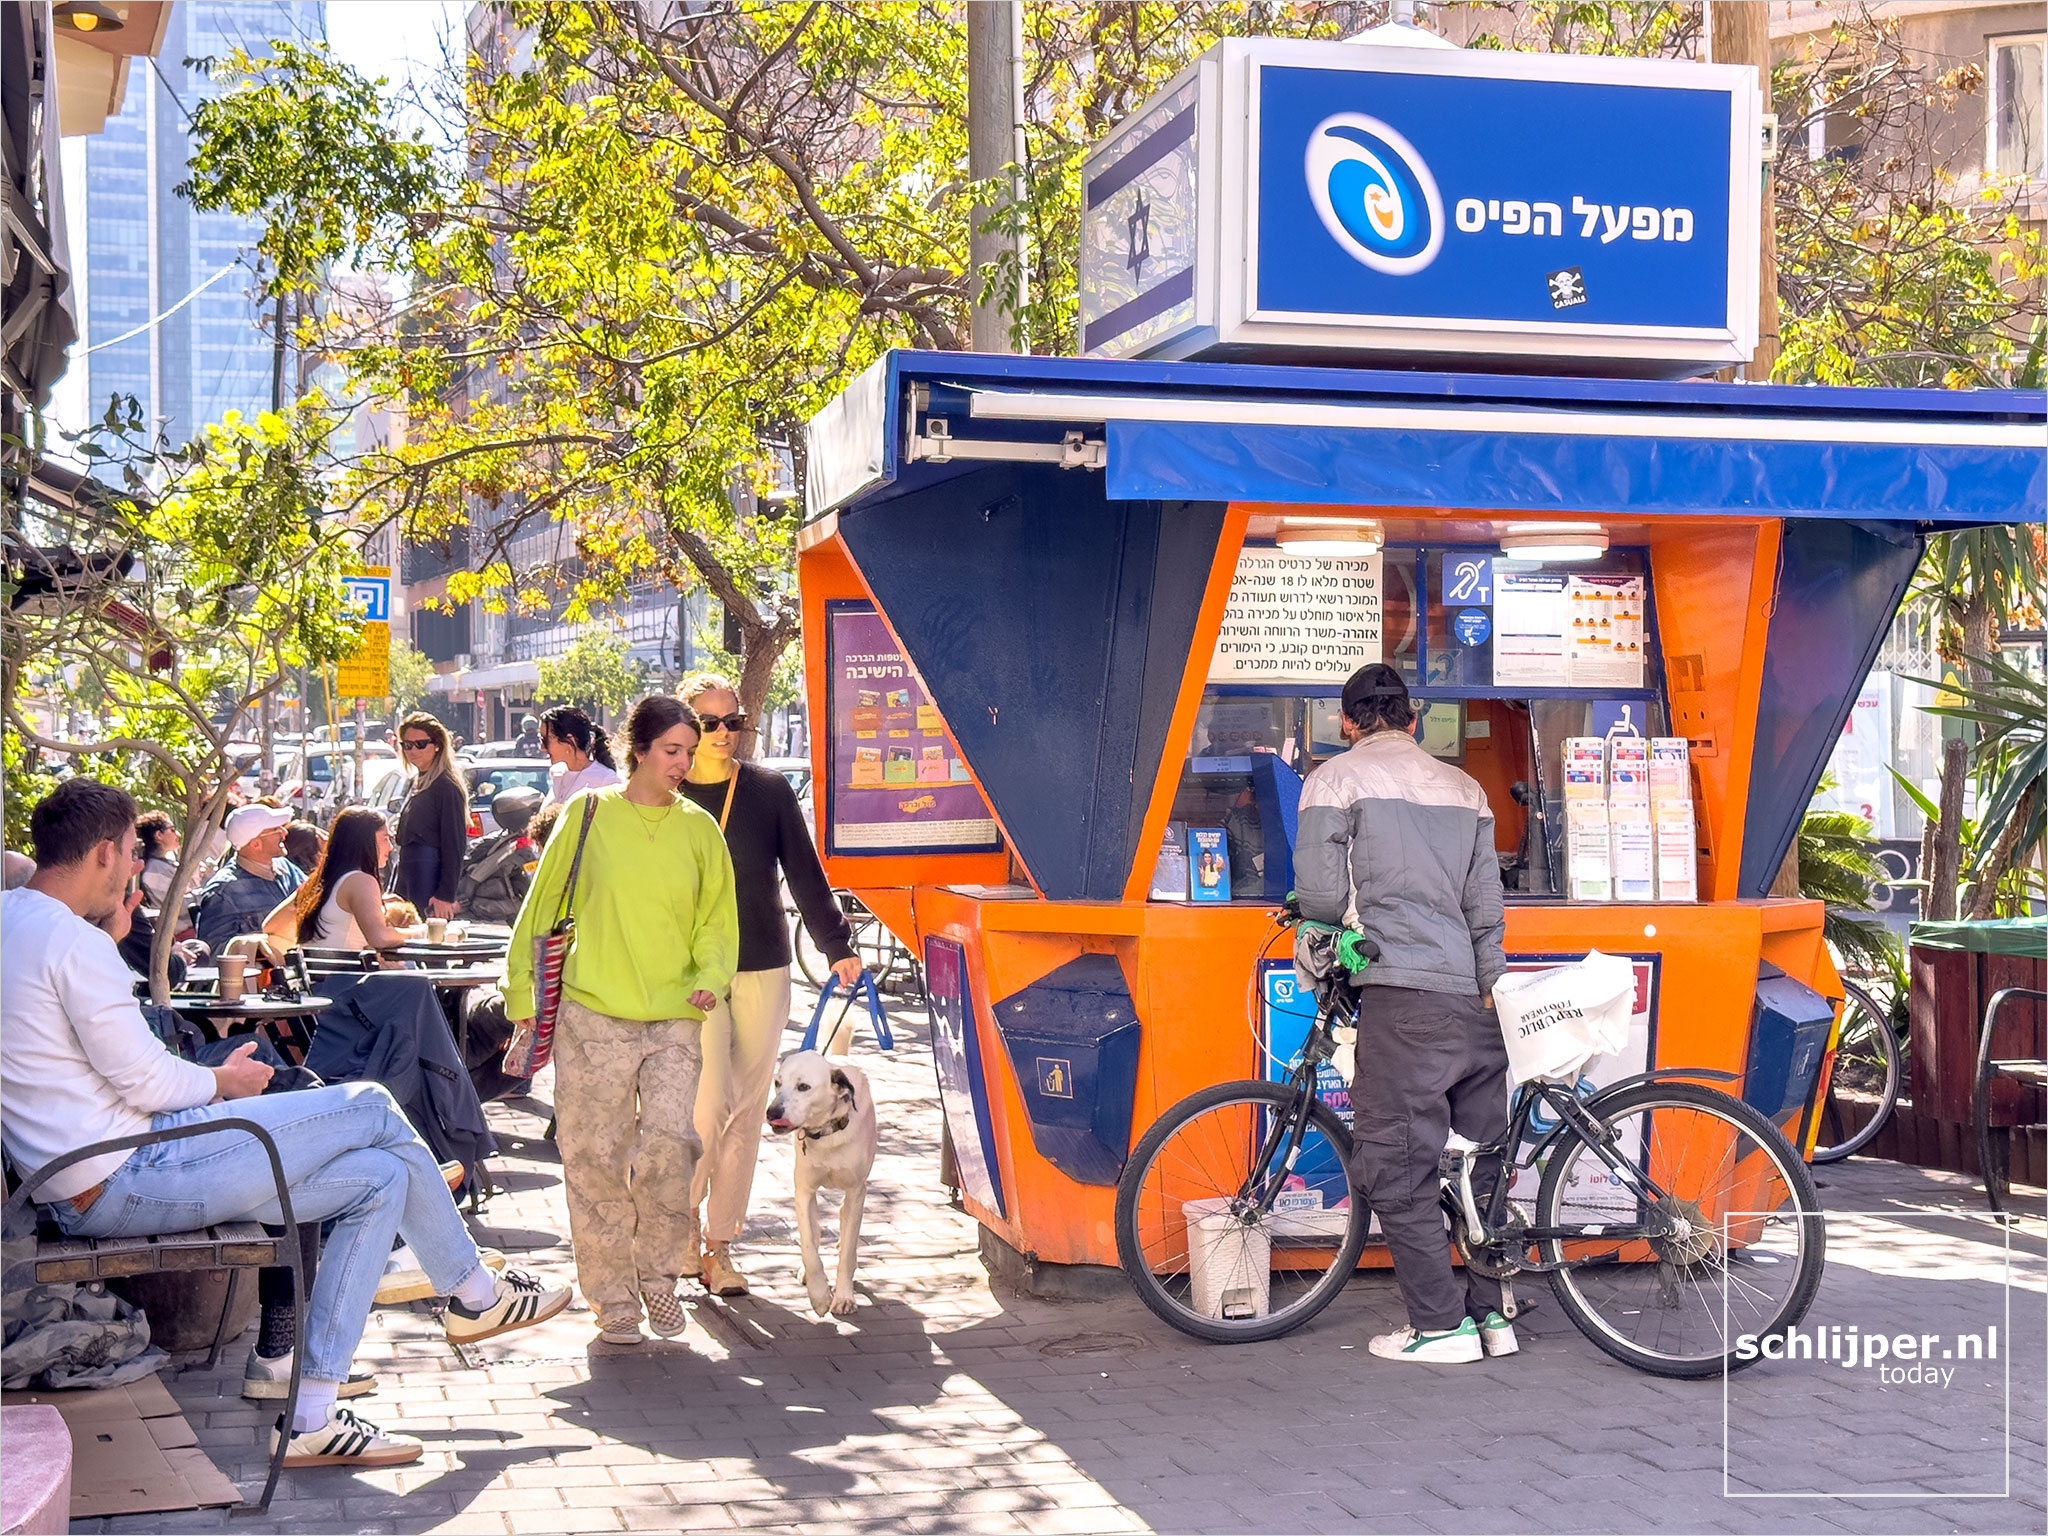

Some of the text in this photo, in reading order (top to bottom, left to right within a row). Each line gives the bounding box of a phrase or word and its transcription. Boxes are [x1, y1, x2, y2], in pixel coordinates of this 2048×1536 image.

[1455, 195, 1694, 245] מפעל הפיס
[1553, 295, 1587, 309] CASUALS
[1239, 556, 1369, 572] מכירה של כרטיס הגרלה
[1281, 575, 1294, 586] 18
[1297, 574, 1307, 587] לו
[1311, 575, 1338, 588] מלאו
[1342, 577, 1375, 589] שטרם
[1241, 592, 1277, 603] תעודה
[1279, 592, 1313, 604] לדרוש
[1315, 593, 1343, 604] רשאי
[1345, 594, 1378, 606] המוכר
[1477, 586, 1490, 603] T
[1247, 608, 1280, 619] מכירה
[1282, 608, 1297, 620] על
[1299, 609, 1333, 621] מוחלט
[1336, 611, 1364, 622] איסור
[1366, 610, 1380, 623] חל
[1263, 626, 1301, 637] הרווחה
[1220, 641, 1364, 656] החברתיים קובע, כי הימורים
[845, 653, 875, 663] הברכה
[1233, 658, 1352, 672] עלולים להיות ממכרים.
[846, 664, 903, 680] הישיבה
[1520, 999, 1572, 1023] FOOTWEAR
[1517, 1007, 1584, 1039] REPUBLIC
[1590, 1173, 1608, 1184] לוטו
